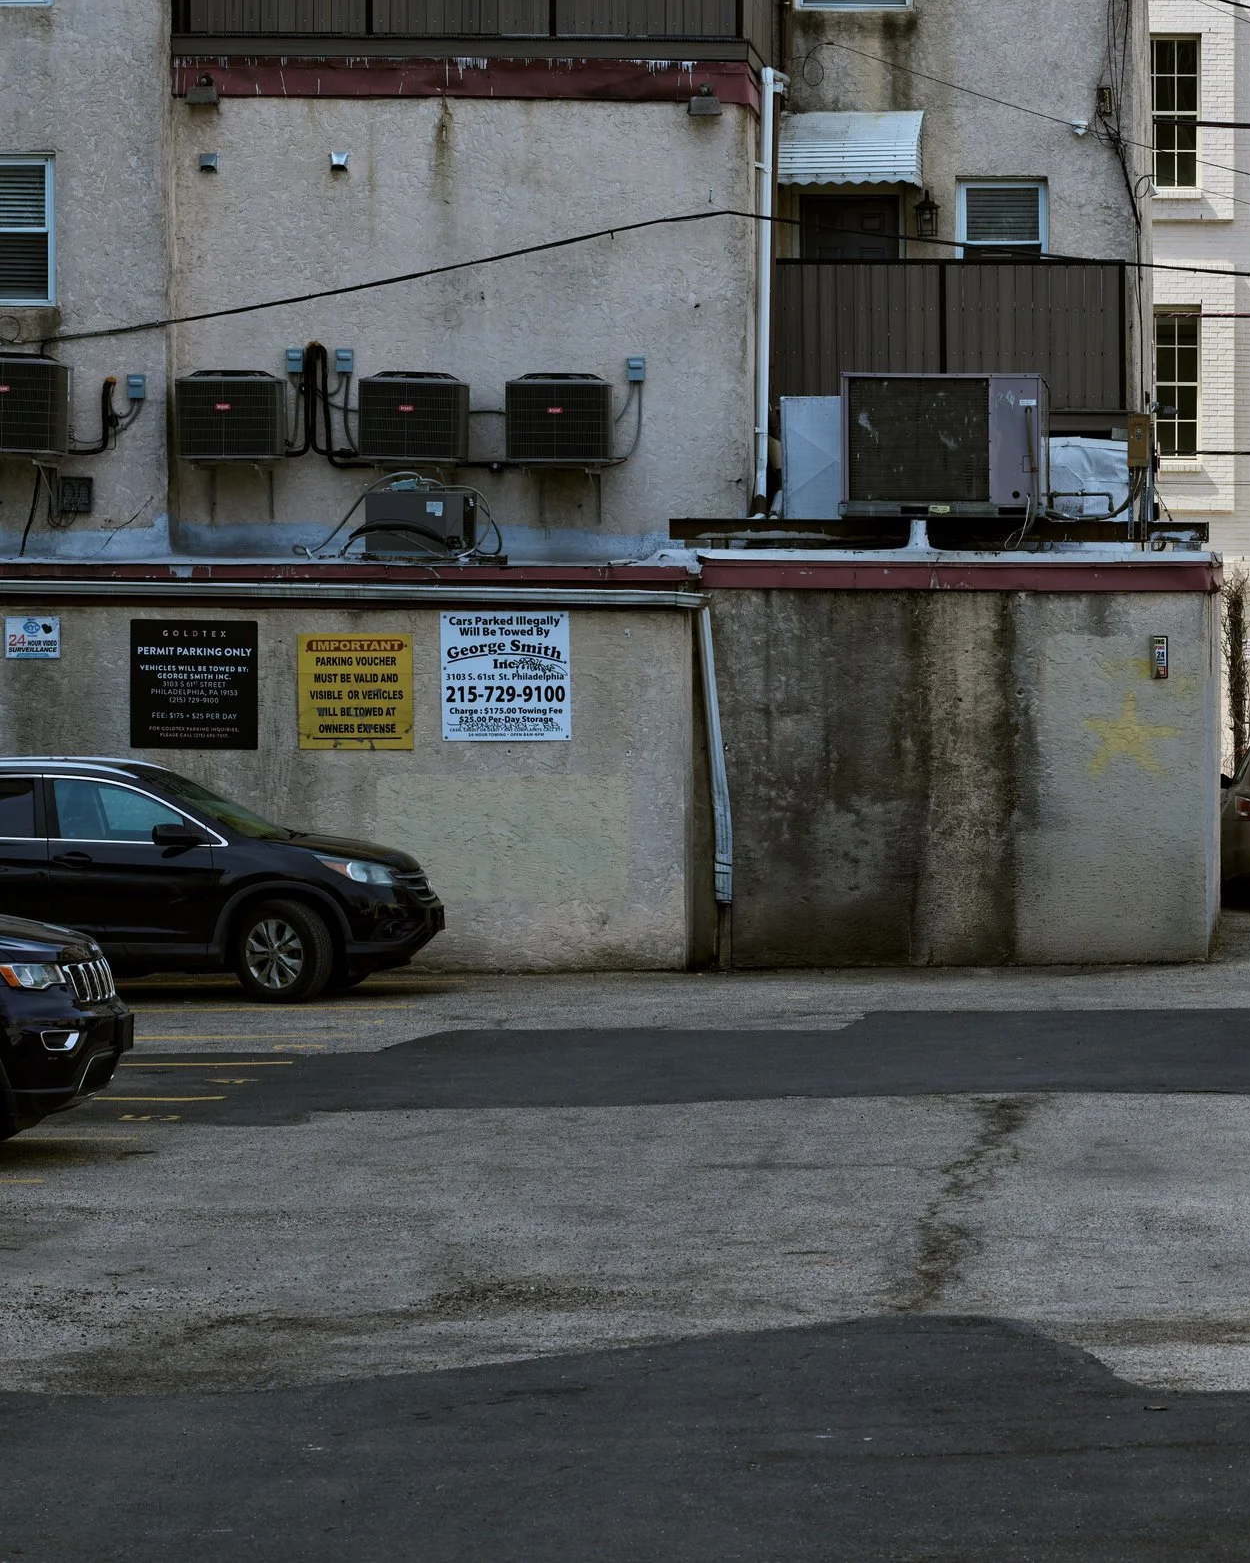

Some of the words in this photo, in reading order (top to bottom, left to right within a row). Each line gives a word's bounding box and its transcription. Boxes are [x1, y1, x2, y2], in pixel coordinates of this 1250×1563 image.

[449, 617, 472, 625] Cars
[475, 617, 513, 625] Parked
[516, 616, 560, 627] Illegally
[459, 627, 480, 636] Will
[482, 627, 496, 636] Be
[498, 627, 533, 636] Towed
[536, 627, 550, 638] By
[9, 634, 26, 646] 24
[312, 641, 401, 650] IMPORTANT
[447, 641, 506, 659] George
[510, 640, 561, 660] Smith
[137, 646, 174, 655] PERMIT
[177, 647, 221, 656] PARKING
[224, 648, 252, 656] ONLY
[316, 657, 352, 666] PARKING
[356, 657, 396, 666] VOUCHER
[314, 674, 338, 682] MUST
[341, 674, 351, 682] BE
[354, 674, 378, 682] VALID
[381, 674, 398, 682] AND
[512, 673, 565, 682] Philadelphia
[151, 688, 207, 696] PHILADELPHIA,
[310, 690, 343, 700] VISIBLE
[347, 690, 359, 699] OR
[362, 690, 403, 699] VEHICLES
[446, 686, 566, 703] 215-729-9100
[317, 707, 338, 716] WILL
[341, 707, 351, 716] BE
[354, 707, 383, 716] TOWED
[386, 707, 396, 716] AT
[484, 707, 517, 715] $175.00
[518, 707, 547, 716] Towing
[459, 716, 487, 724] $25.00
[488, 716, 520, 725] Per-Day
[522, 716, 554, 725] Storage
[319, 724, 354, 733] OWNERS
[357, 724, 396, 733] EXPENSE
